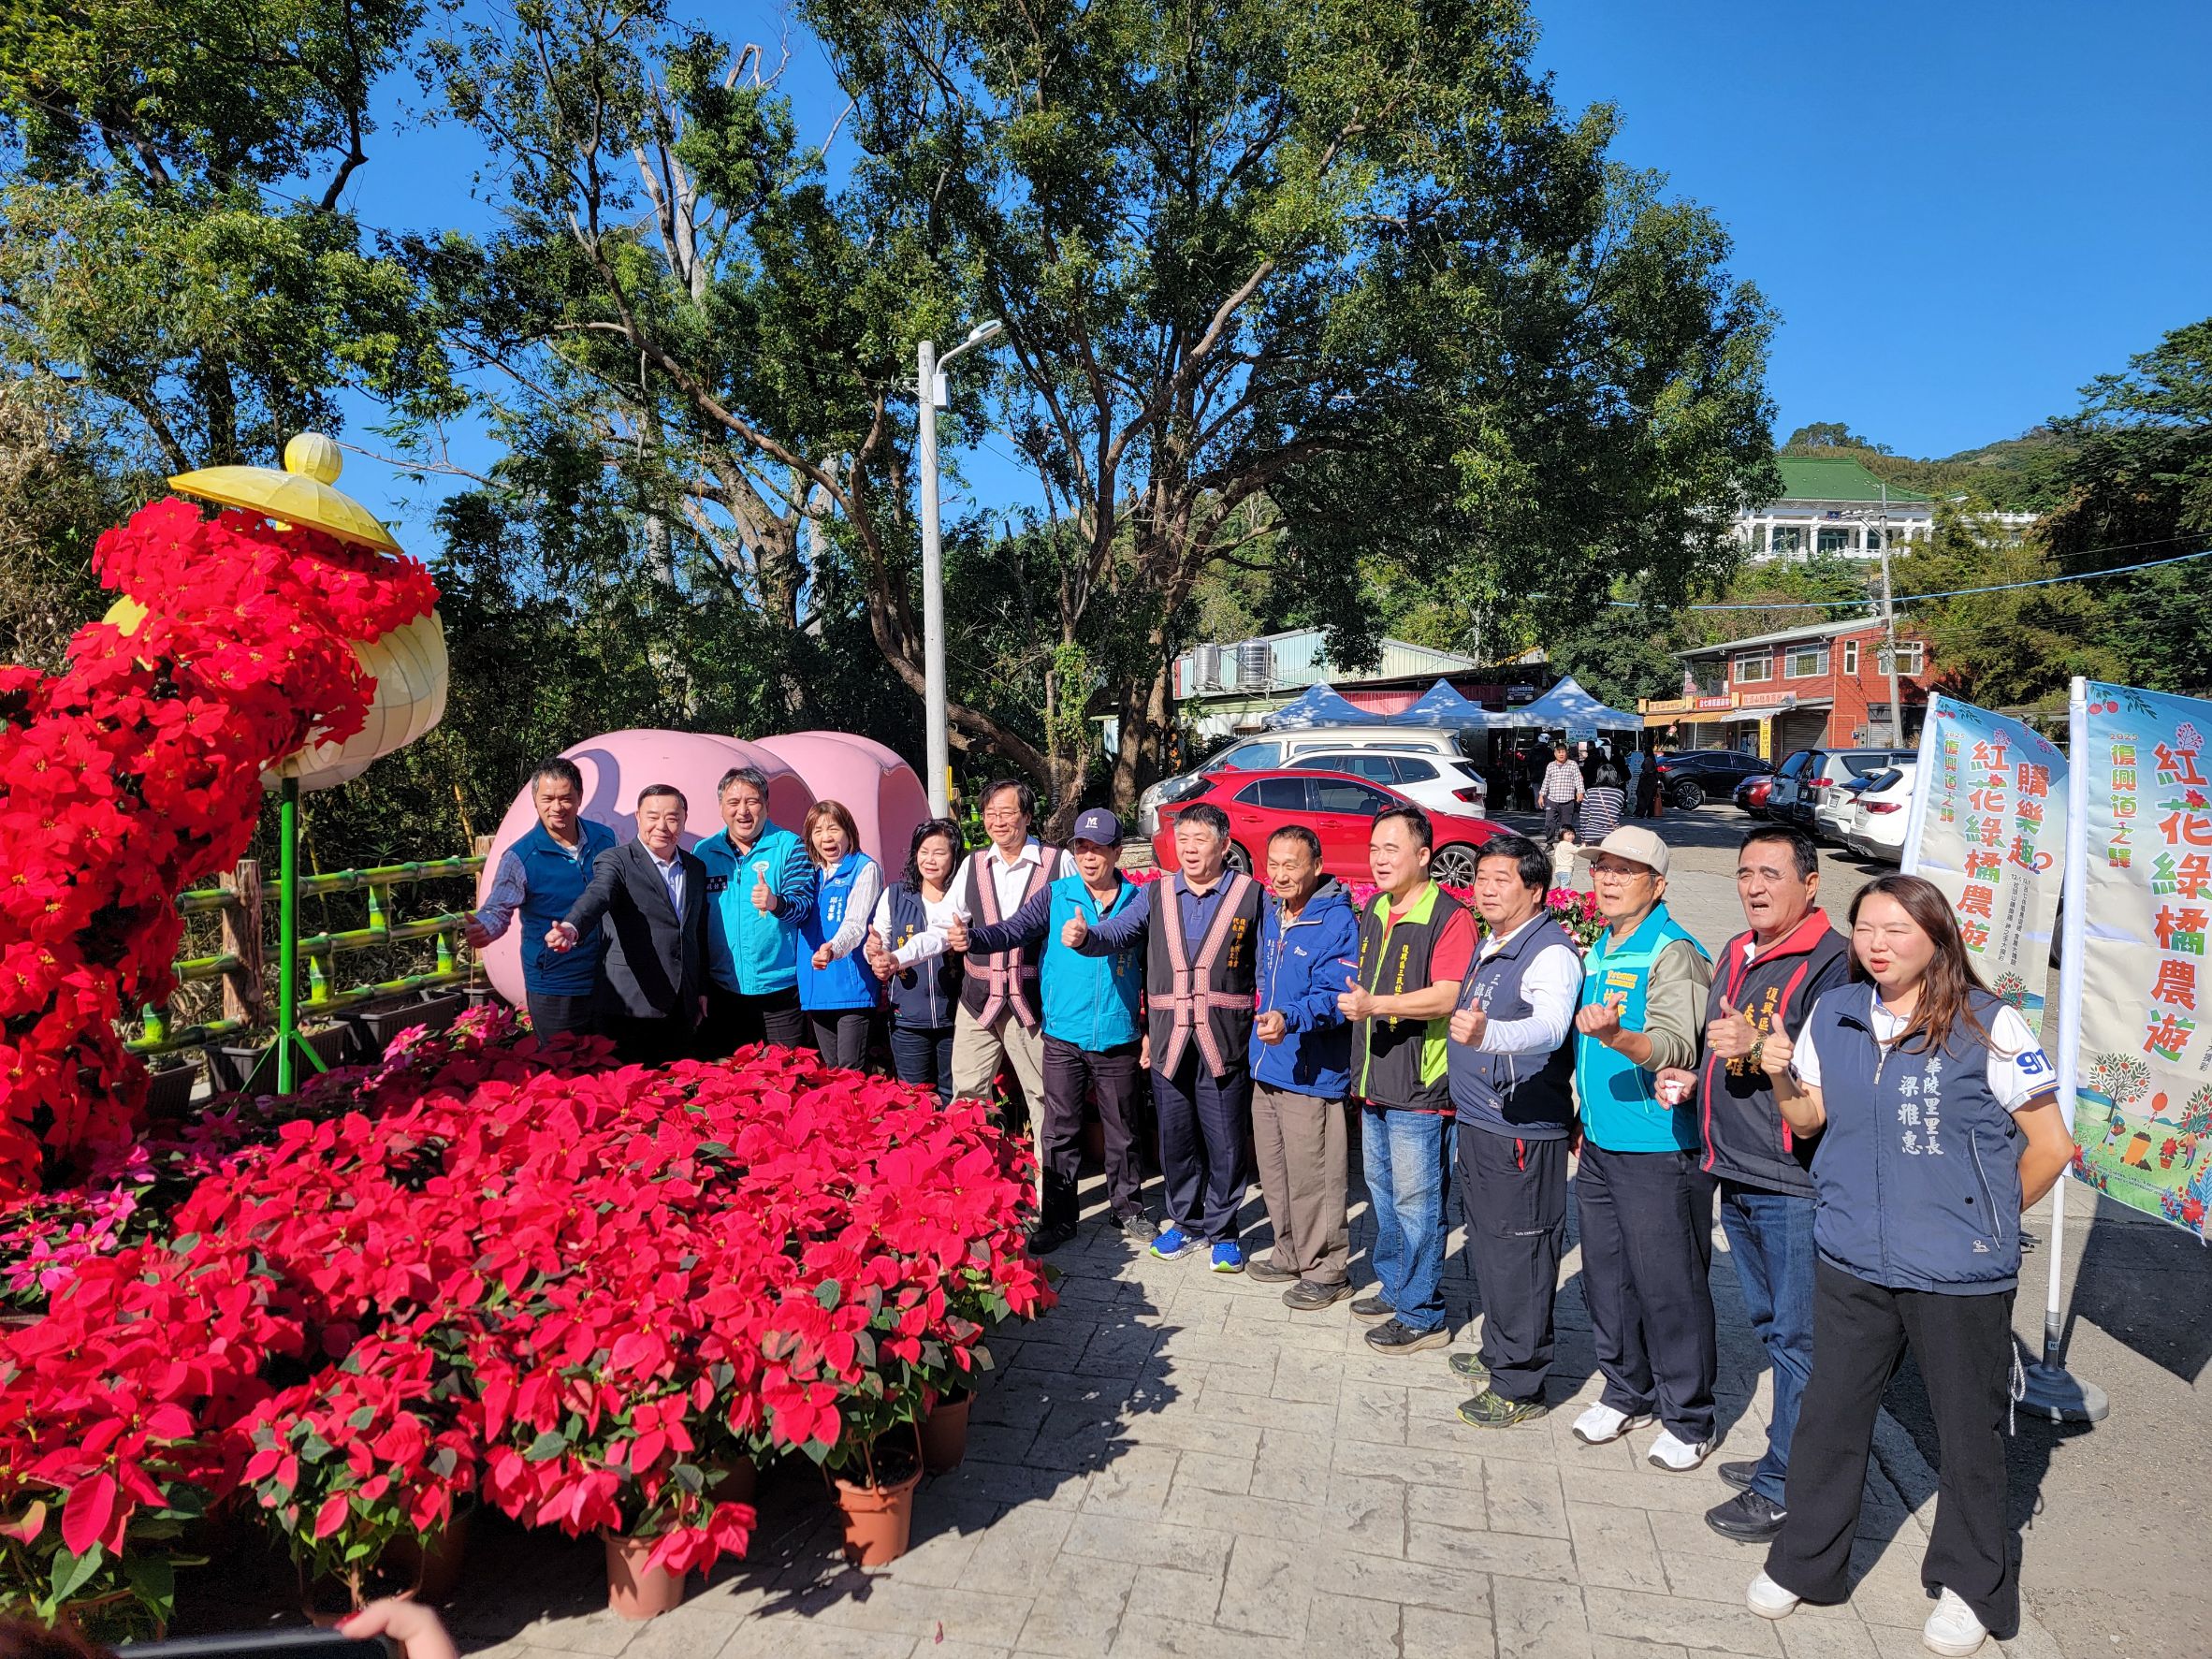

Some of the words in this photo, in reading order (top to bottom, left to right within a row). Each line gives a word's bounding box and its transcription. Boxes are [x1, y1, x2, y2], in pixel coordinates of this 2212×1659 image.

[1939, 739, 1960, 822] 復興道之驛
[2007, 763, 2050, 870] 購樂趣
[2107, 744, 2137, 868] 復興道之驛
[1957, 740, 2010, 953] 紅花綠橘農遊
[2143, 743, 2212, 1063] 紅花綠橘農遊
[1923, 1056, 1944, 1156] 華陵里里長
[2016, 1048, 2054, 1075] 91
[1897, 1075, 1924, 1156] 梁雅惠
